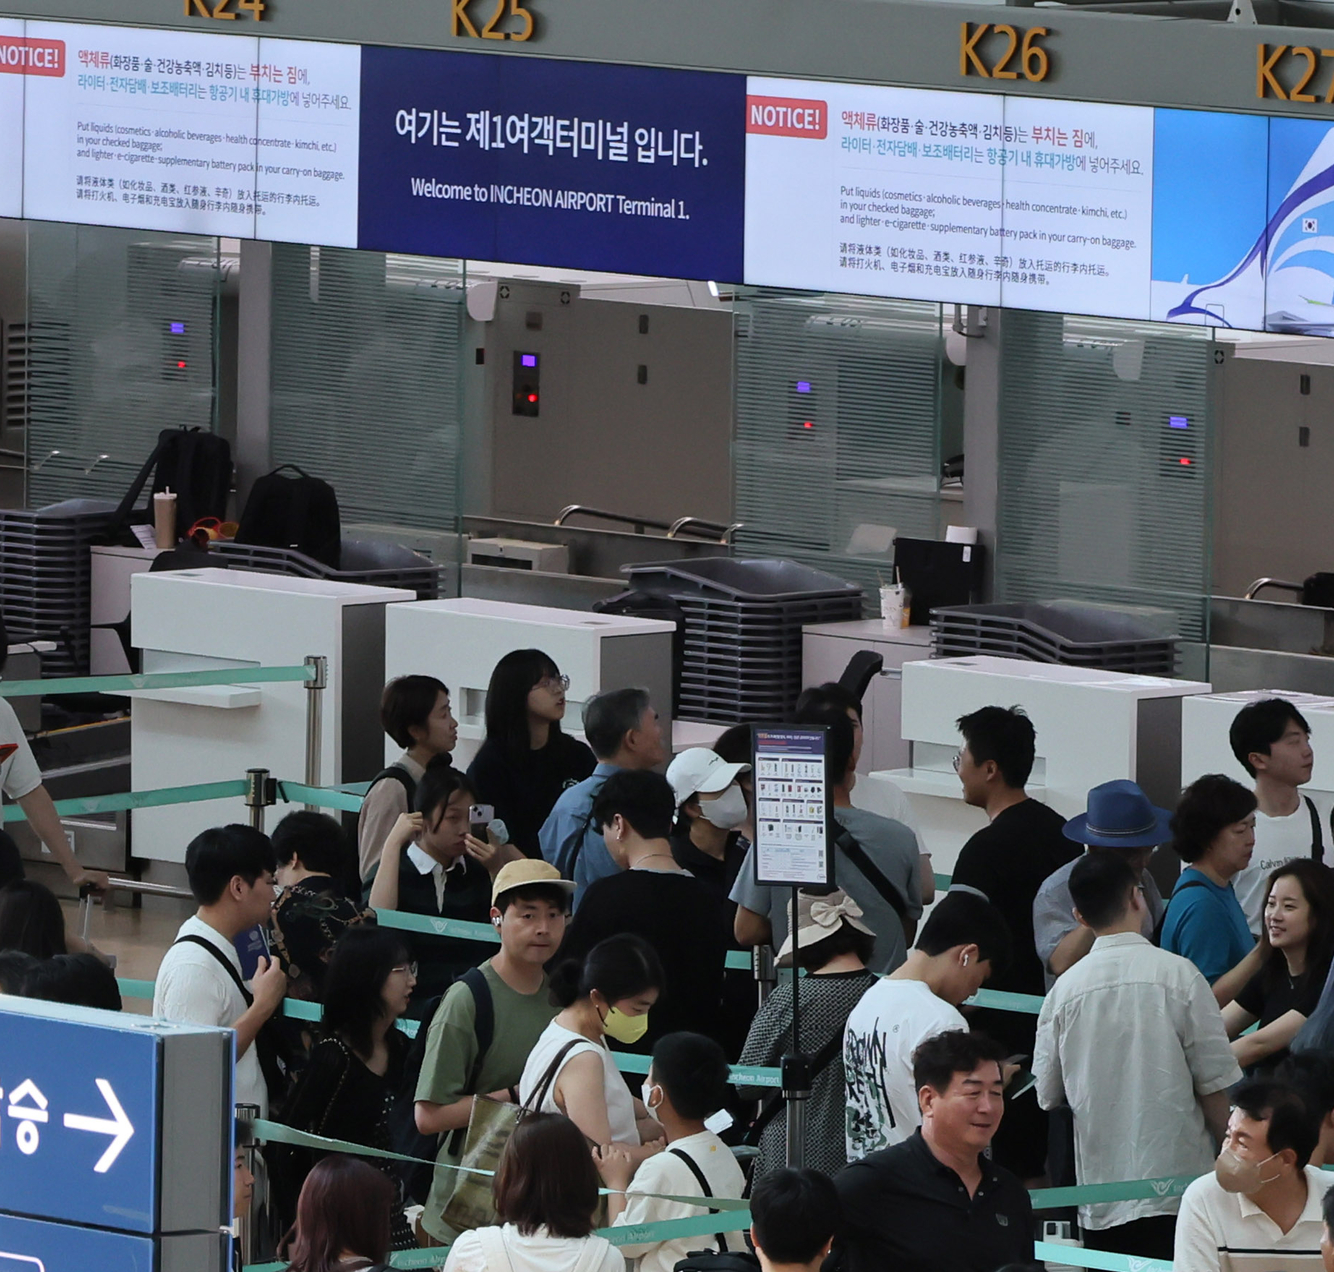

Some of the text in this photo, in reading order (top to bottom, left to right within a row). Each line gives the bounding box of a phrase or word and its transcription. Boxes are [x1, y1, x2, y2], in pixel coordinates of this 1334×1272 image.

[451, 0, 534, 41] K25
[959, 22, 1051, 83] K26
[249, 64, 283, 83] 부치는
[750, 105, 820, 130] NOTICE!
[396, 108, 707, 167] 여기는 제1여객터미널 입니다.
[1032, 126, 1068, 146] 부치는
[987, 148, 1017, 166] 항공기
[1021, 151, 1031, 167] 내
[411, 178, 689, 219] Welcome to INCHEON AIRPORT Terminal 1.
[841, 186, 853, 196] Put
[856, 187, 880, 199] liquids
[849, 203, 866, 212] your
[868, 203, 899, 214] checked
[840, 215, 854, 224] and
[990, 226, 1017, 240] battery
[1019, 230, 1037, 240] pack
[1039, 230, 1046, 240] in
[1048, 234, 1065, 243] your
[1067, 235, 1100, 246] carry-on
